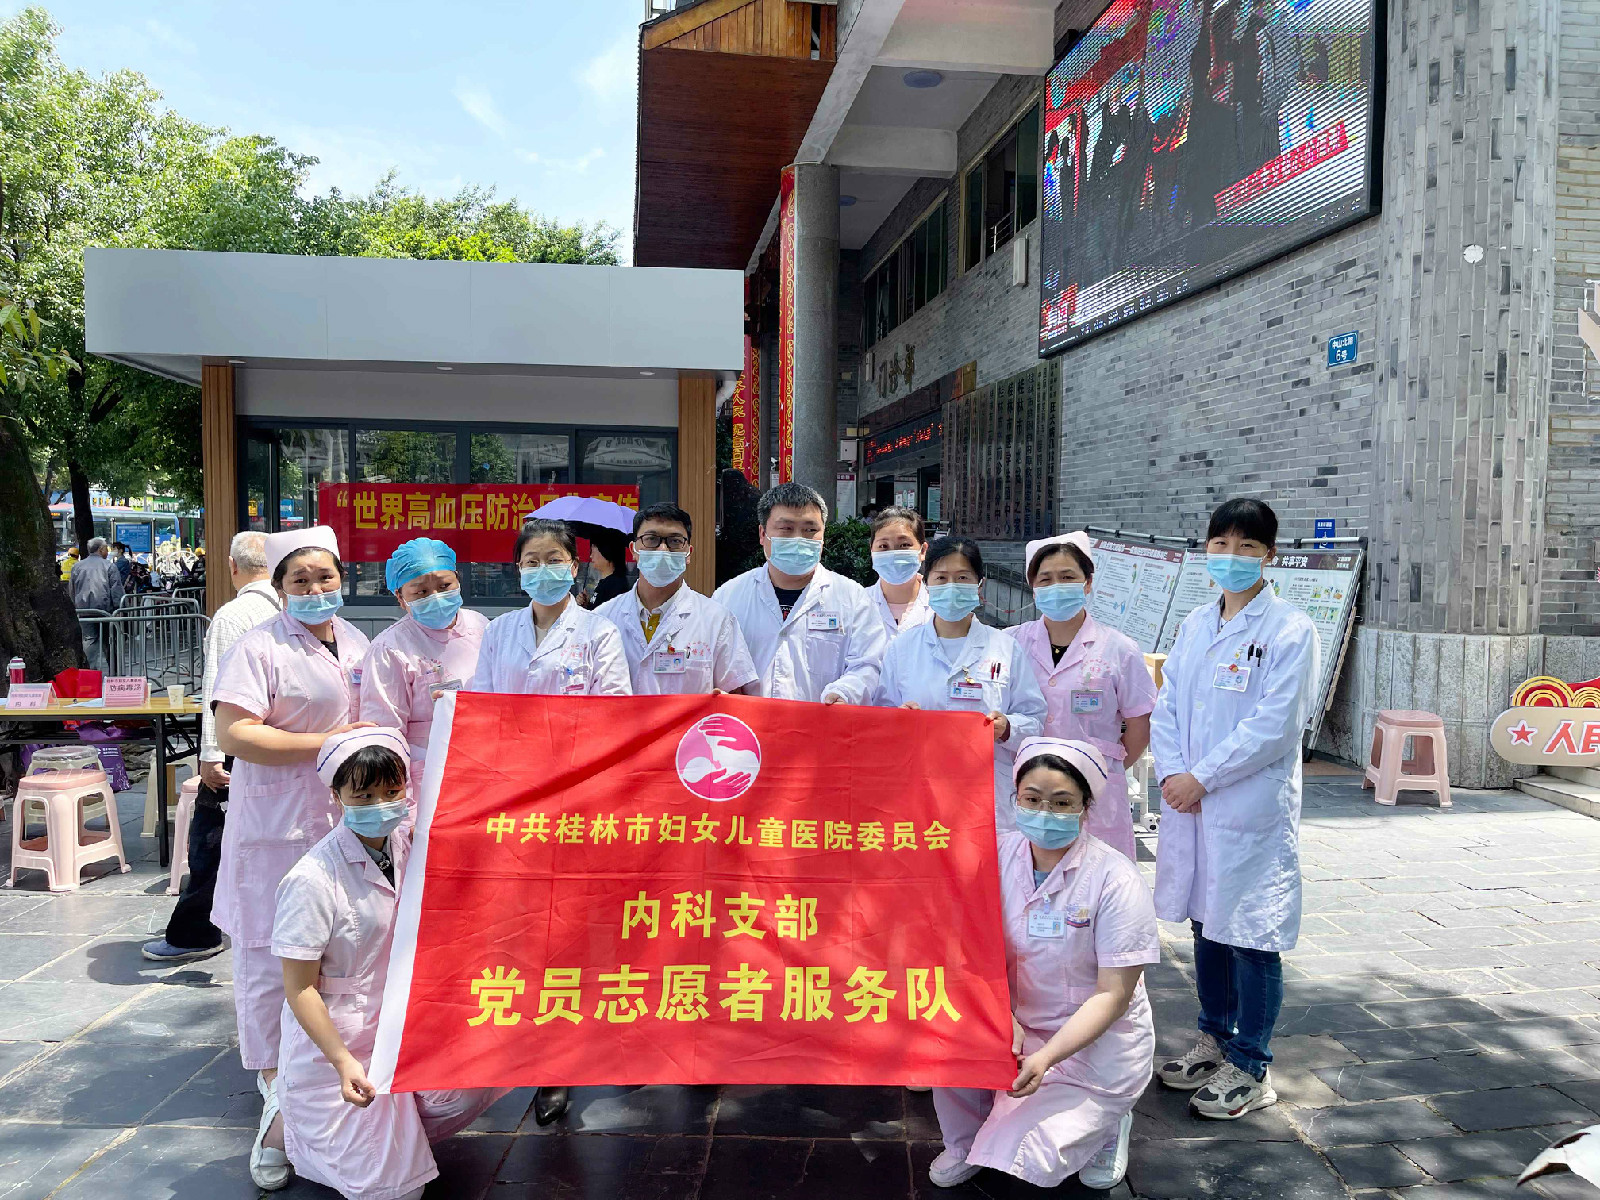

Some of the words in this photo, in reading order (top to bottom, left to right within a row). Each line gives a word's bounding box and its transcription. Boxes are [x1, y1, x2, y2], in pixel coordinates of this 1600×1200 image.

[1335, 349, 1348, 362] 6号
[486, 812, 951, 852] 中共桂林市妇女儿童医院委员会
[621, 890, 818, 942] 内科支部
[467, 962, 963, 1027] 党员志愿者服务队
